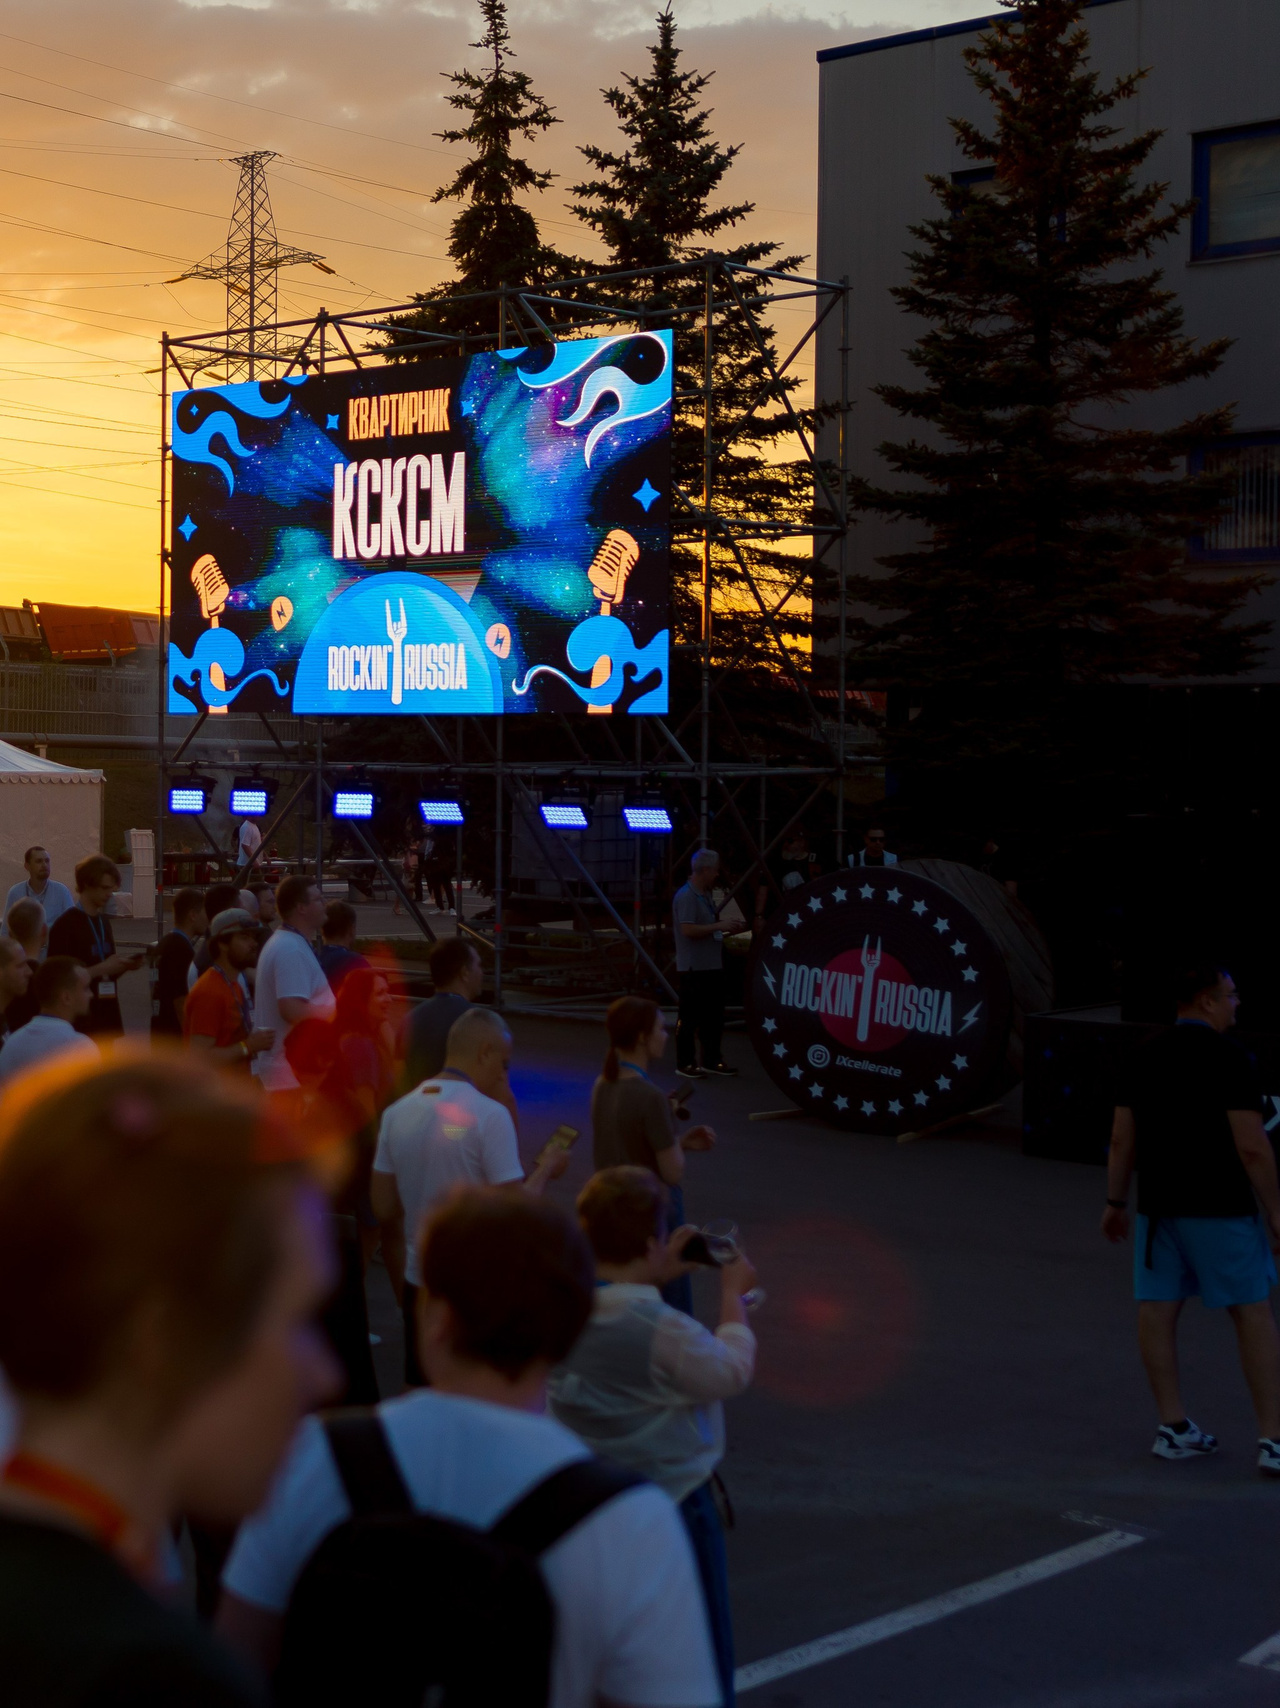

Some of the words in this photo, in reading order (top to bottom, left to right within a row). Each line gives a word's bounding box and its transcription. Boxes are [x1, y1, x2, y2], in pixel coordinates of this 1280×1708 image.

[348, 388, 451, 441] КВАРТИРНИК
[333, 451, 466, 559] КСКСМ
[327, 644, 393, 691] ROCKIN'
[403, 642, 468, 690] RUSSIA
[780, 962, 864, 1018] ROCKIN'
[873, 979, 953, 1037] RUSSIA
[835, 1054, 903, 1078] IXcellerate
